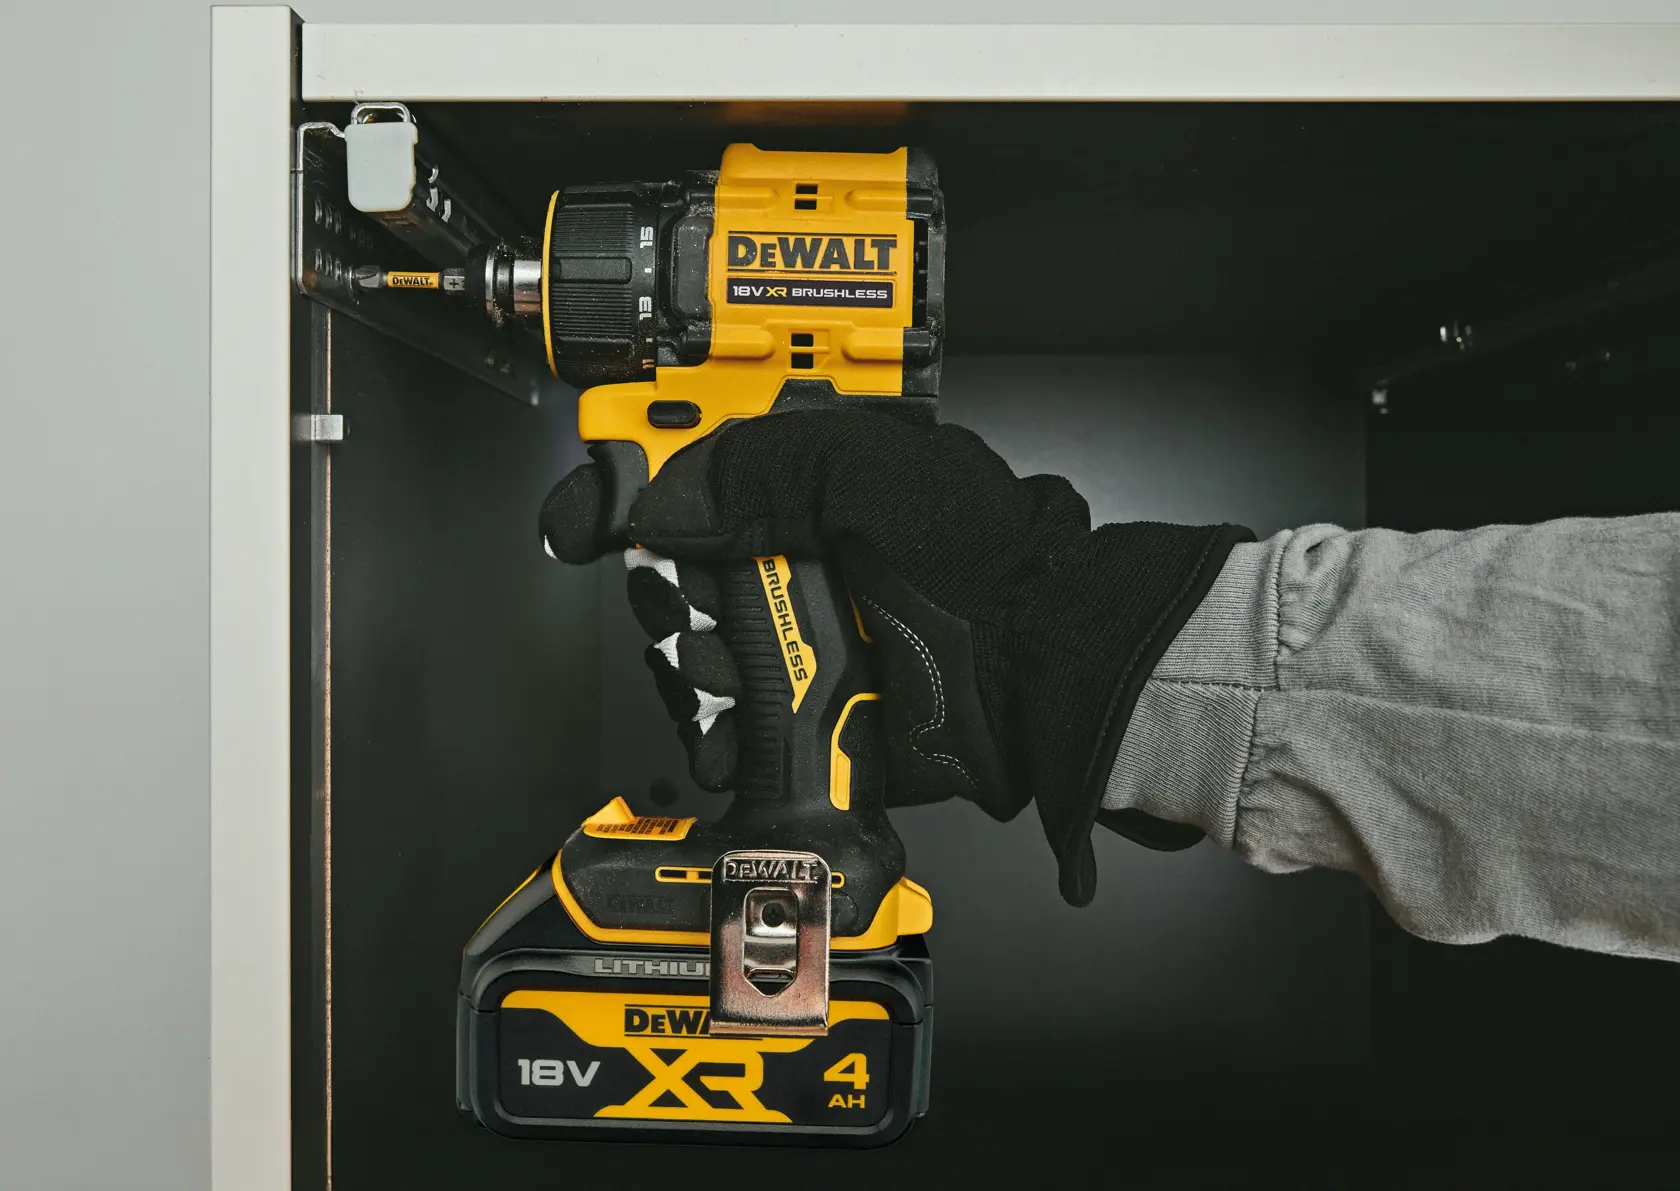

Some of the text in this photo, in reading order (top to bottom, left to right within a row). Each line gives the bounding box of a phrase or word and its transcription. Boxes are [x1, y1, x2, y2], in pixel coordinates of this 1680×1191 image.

[640, 226, 654, 249] 15
[733, 285, 888, 300] 18V XR BRUSHLESS
[638, 296, 652, 321] 13
[762, 558, 809, 682] BRUSHLESS
[594, 958, 710, 977] LITHIU
[624, 1007, 710, 1036] DEW
[517, 1058, 601, 1088] 18V
[594, 1045, 793, 1123] XR
[823, 1052, 870, 1091] 4
[828, 1093, 866, 1109] AH
